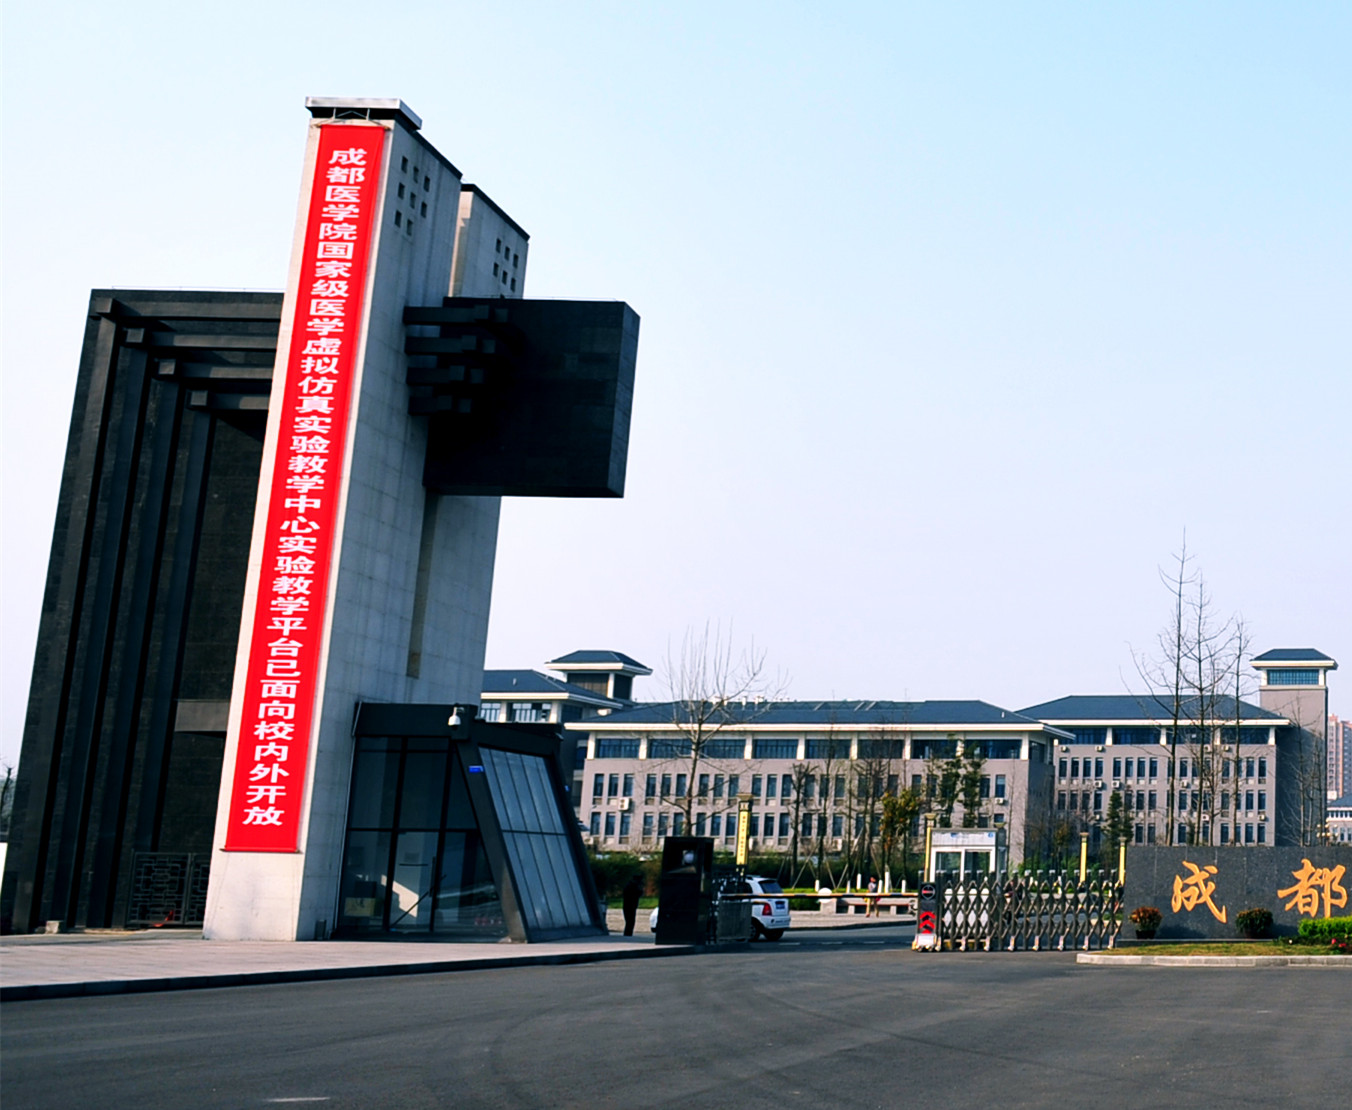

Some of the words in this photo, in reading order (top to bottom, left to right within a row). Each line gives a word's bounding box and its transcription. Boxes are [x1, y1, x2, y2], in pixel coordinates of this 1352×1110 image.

[242, 148, 367, 826] 成都医学院国家级医学虚拟仿真实验教学中心实验教学平台已面向校内外开放
